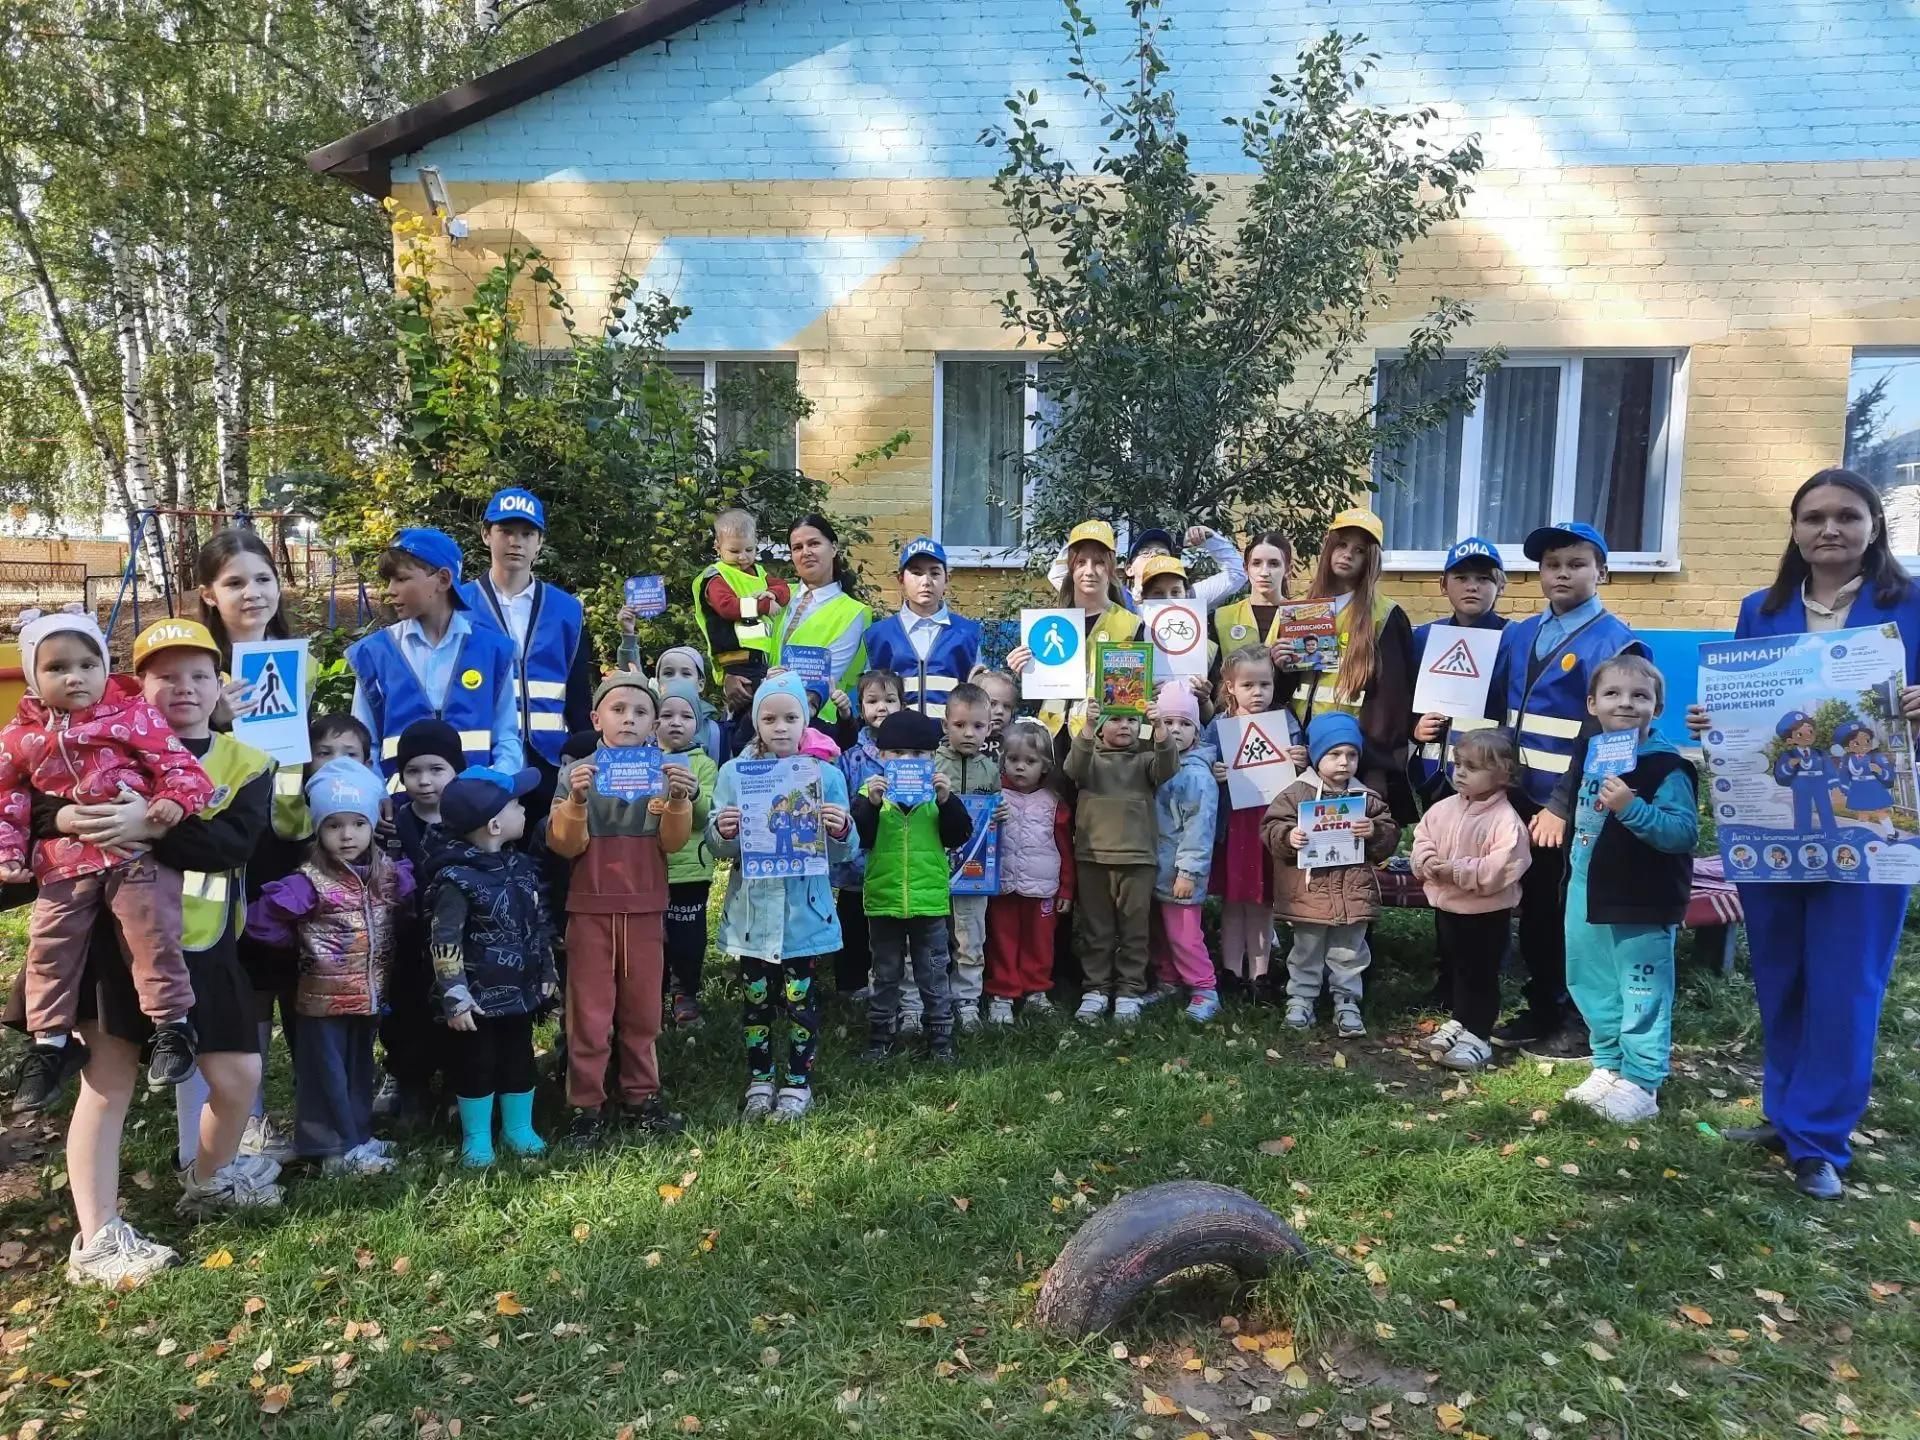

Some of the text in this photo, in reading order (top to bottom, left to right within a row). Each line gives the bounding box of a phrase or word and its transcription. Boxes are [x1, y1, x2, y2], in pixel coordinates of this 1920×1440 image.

[500, 496, 535, 516] ЮИД
[908, 540, 935, 557] ЮИД
[1455, 538, 1490, 558] ЮИД
[1780, 667, 1814, 677] НЕДЕЛЯ
[1705, 677, 1803, 692] БЕЗОПАСНОСТИ
[1704, 688, 1784, 702] ДОРОЖНОГО
[1705, 699, 1775, 713] ДВИЖЕНИЯ
[1314, 803, 1350, 817] ПДД
[1312, 821, 1351, 832] ДЕТЕЙ
[667, 912, 696, 921] BEAR
